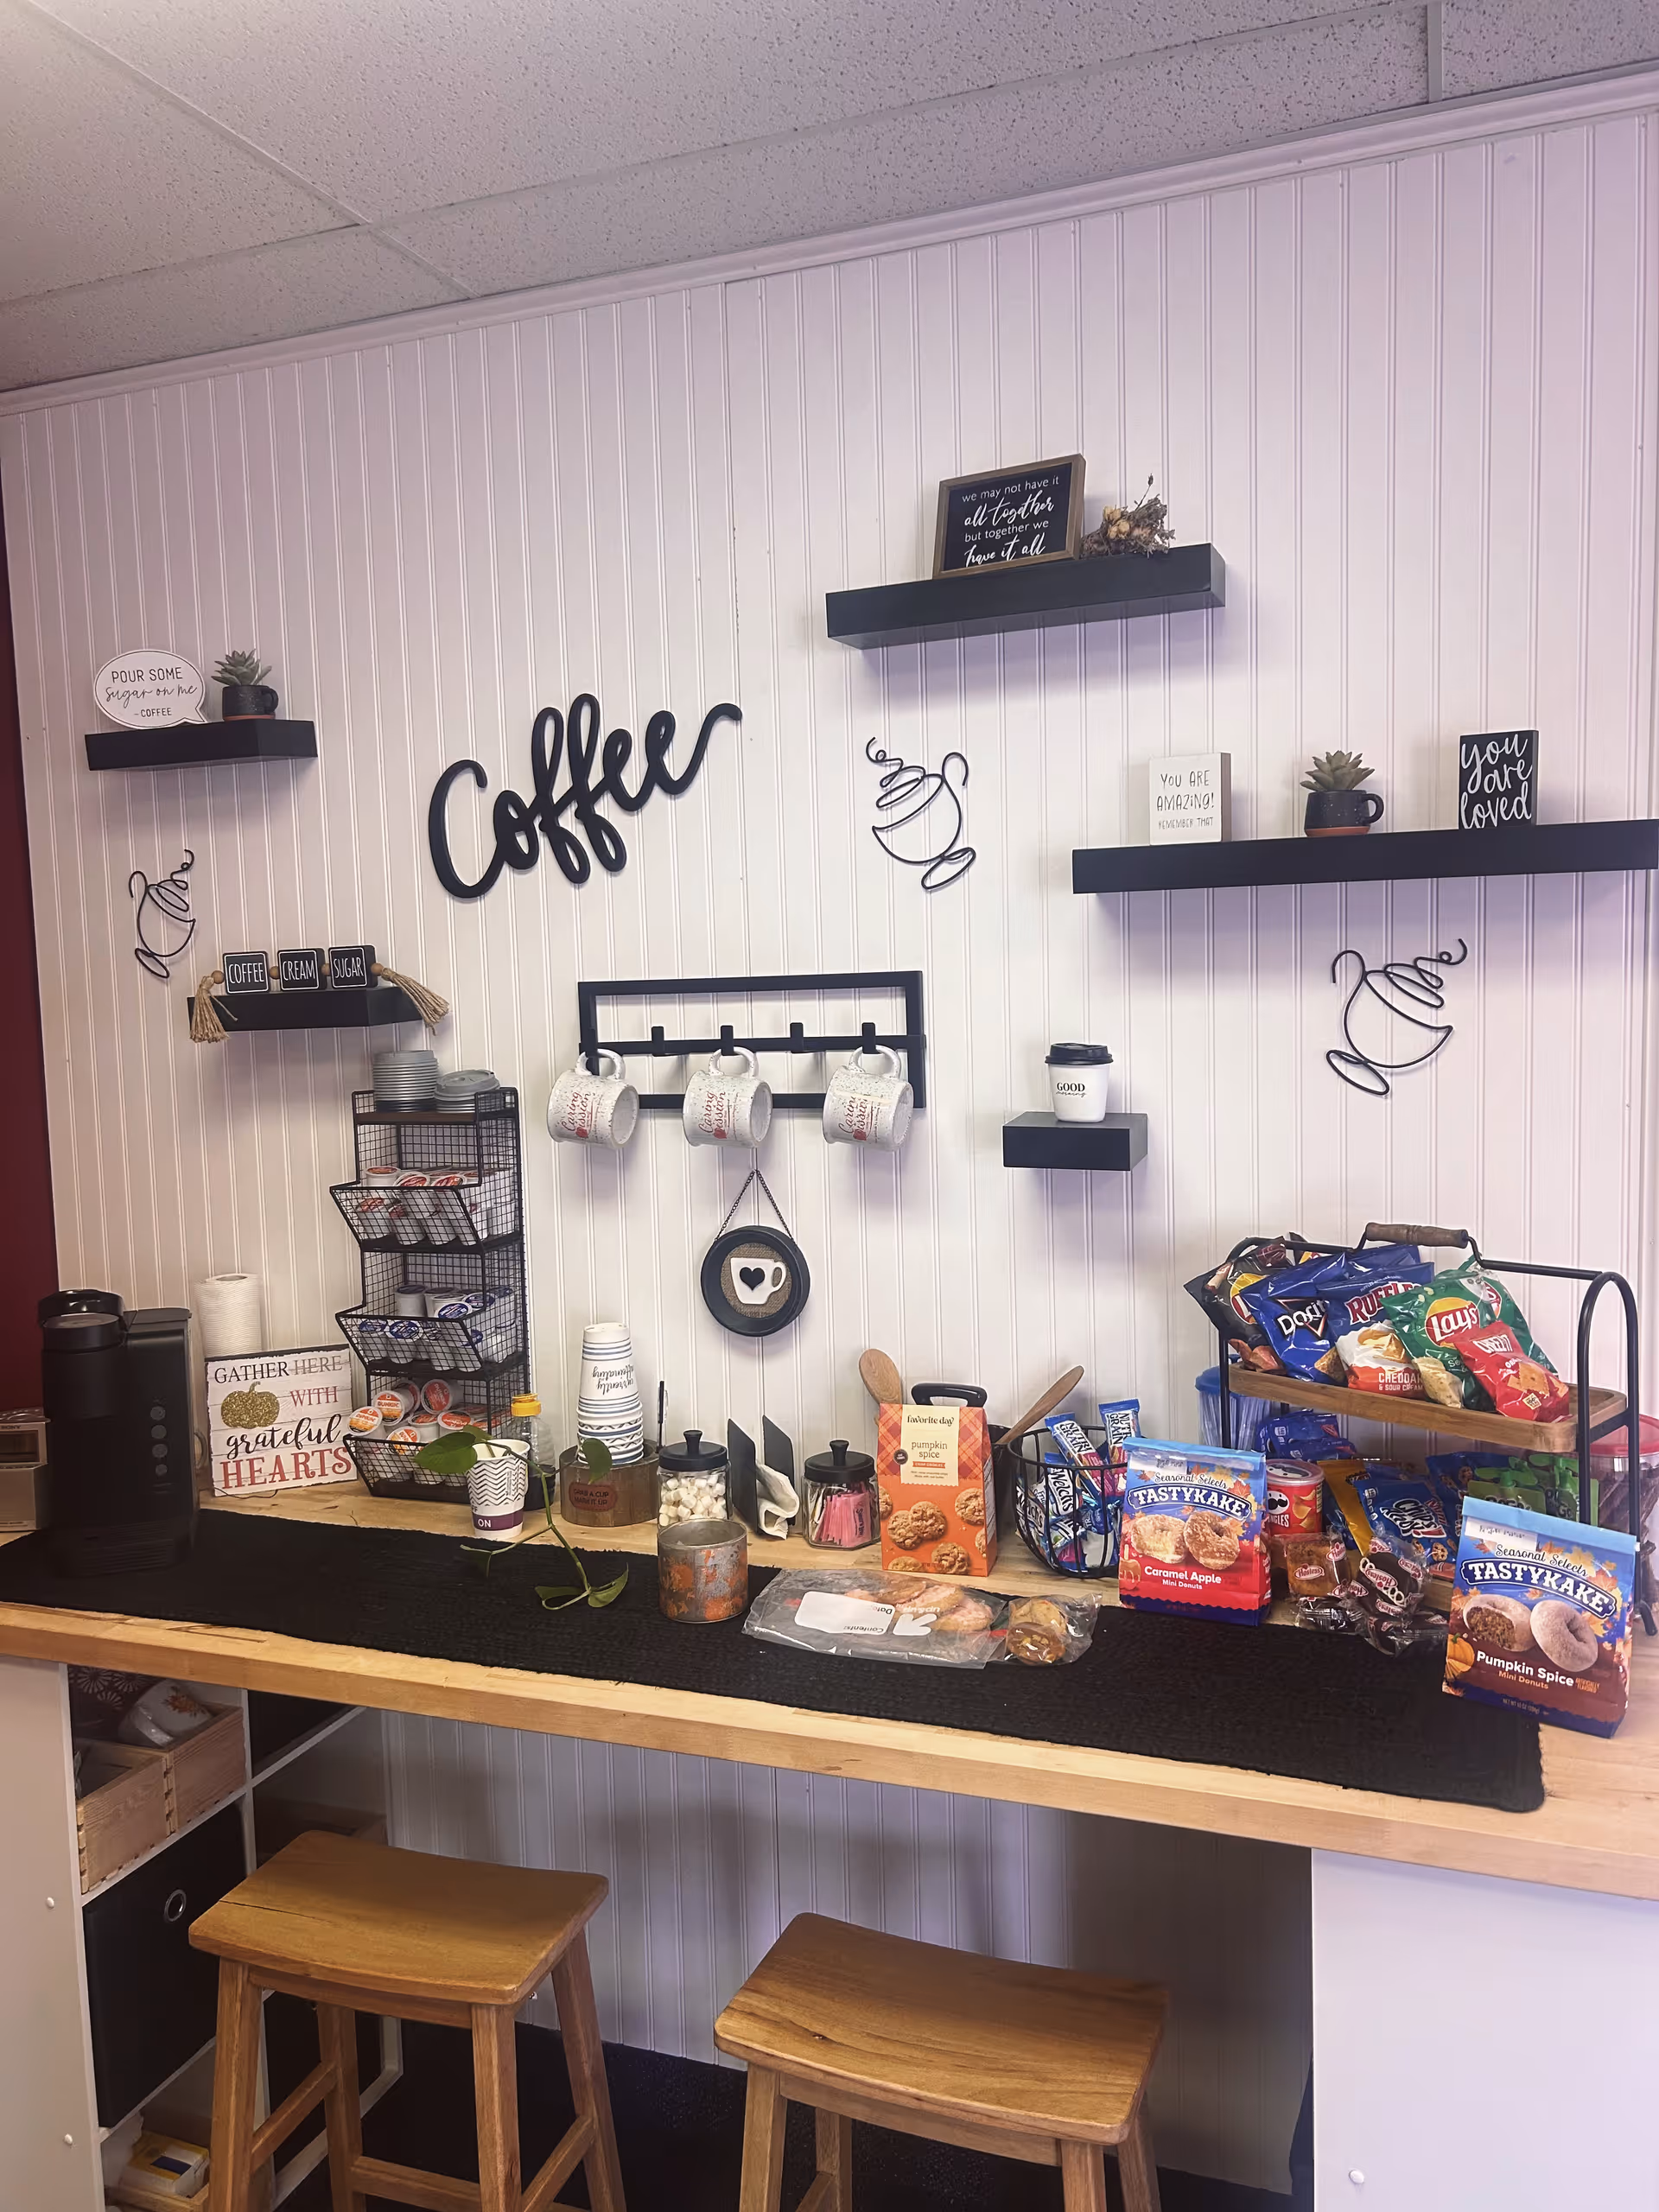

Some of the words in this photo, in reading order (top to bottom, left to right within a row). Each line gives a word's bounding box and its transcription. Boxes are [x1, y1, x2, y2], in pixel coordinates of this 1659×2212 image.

[962, 493, 977, 503] we
[981, 488, 1001, 501] may
[1005, 482, 1021, 494] not
[1025, 478, 1049, 491] have
[1052, 475, 1059, 486] it
[964, 504, 988, 527] all
[988, 489, 1054, 525] together
[965, 531, 981, 543] but
[985, 522, 1030, 540] together
[1033, 520, 1049, 530] we
[964, 544, 995, 568] have
[1001, 534, 1019, 561] it
[1021, 531, 1046, 556] all
[111, 669, 144, 683] POUR
[149, 666, 183, 681] SOME
[156, 687, 175, 696] on
[177, 683, 198, 696] me
[1461, 734, 1528, 793] you
[1190, 770, 1210, 787] ARE
[1484, 760, 1532, 793] are
[429, 693, 742, 899] Coffee
[1461, 781, 1531, 829] loved
[1159, 818, 1193, 830] REMEMBER
[1197, 817, 1213, 826] THAT
[228, 963, 264, 984] COFFEE
[283, 959, 315, 981] CREAM
[334, 957, 364, 978] SUGAR
[1057, 1082, 1085, 1092] GOOD
[1433, 1306, 1478, 1343] Lay's
[215, 1361, 289, 1384] GATHER
[294, 1355, 343, 1376] HERE
[290, 1386, 339, 1408] WITH
[907, 1414, 938, 1424] favorite
[938, 1416, 954, 1427] day
[1109, 1413, 1122, 1445] GRAIN
[226, 1414, 342, 1460] grateful
[912, 1440, 947, 1451] pumpkin
[1059, 1423, 1085, 1453] GRAIN
[1065, 1422, 1093, 1452] NUTRI
[918, 1451, 940, 1459] spice
[219, 1446, 352, 1490] HEARTS
[1154, 1471, 1194, 1483] Seasonal
[1198, 1473, 1227, 1489] Selects
[1134, 1484, 1246, 1517] TASTYKAKE
[478, 1519, 492, 1528] ON
[1496, 1543, 1547, 1562] Seasonal
[1549, 1554, 1588, 1577] Selects
[1144, 1566, 1189, 1580] Caramel
[1191, 1571, 1222, 1584] Apple
[1299, 1567, 1321, 1577] Hostess
[1366, 1569, 1395, 1589] Hostess
[1162, 1579, 1177, 1587] Mini
[1178, 1581, 1203, 1590] Donuts
[1469, 1562, 1610, 1613] TASTYKAKE
[1477, 1649, 1535, 1677] Pumpkin
[1537, 1666, 1574, 1687] Spice
[1498, 1670, 1516, 1681] Mini
[1518, 1675, 1549, 1689] Donuts
